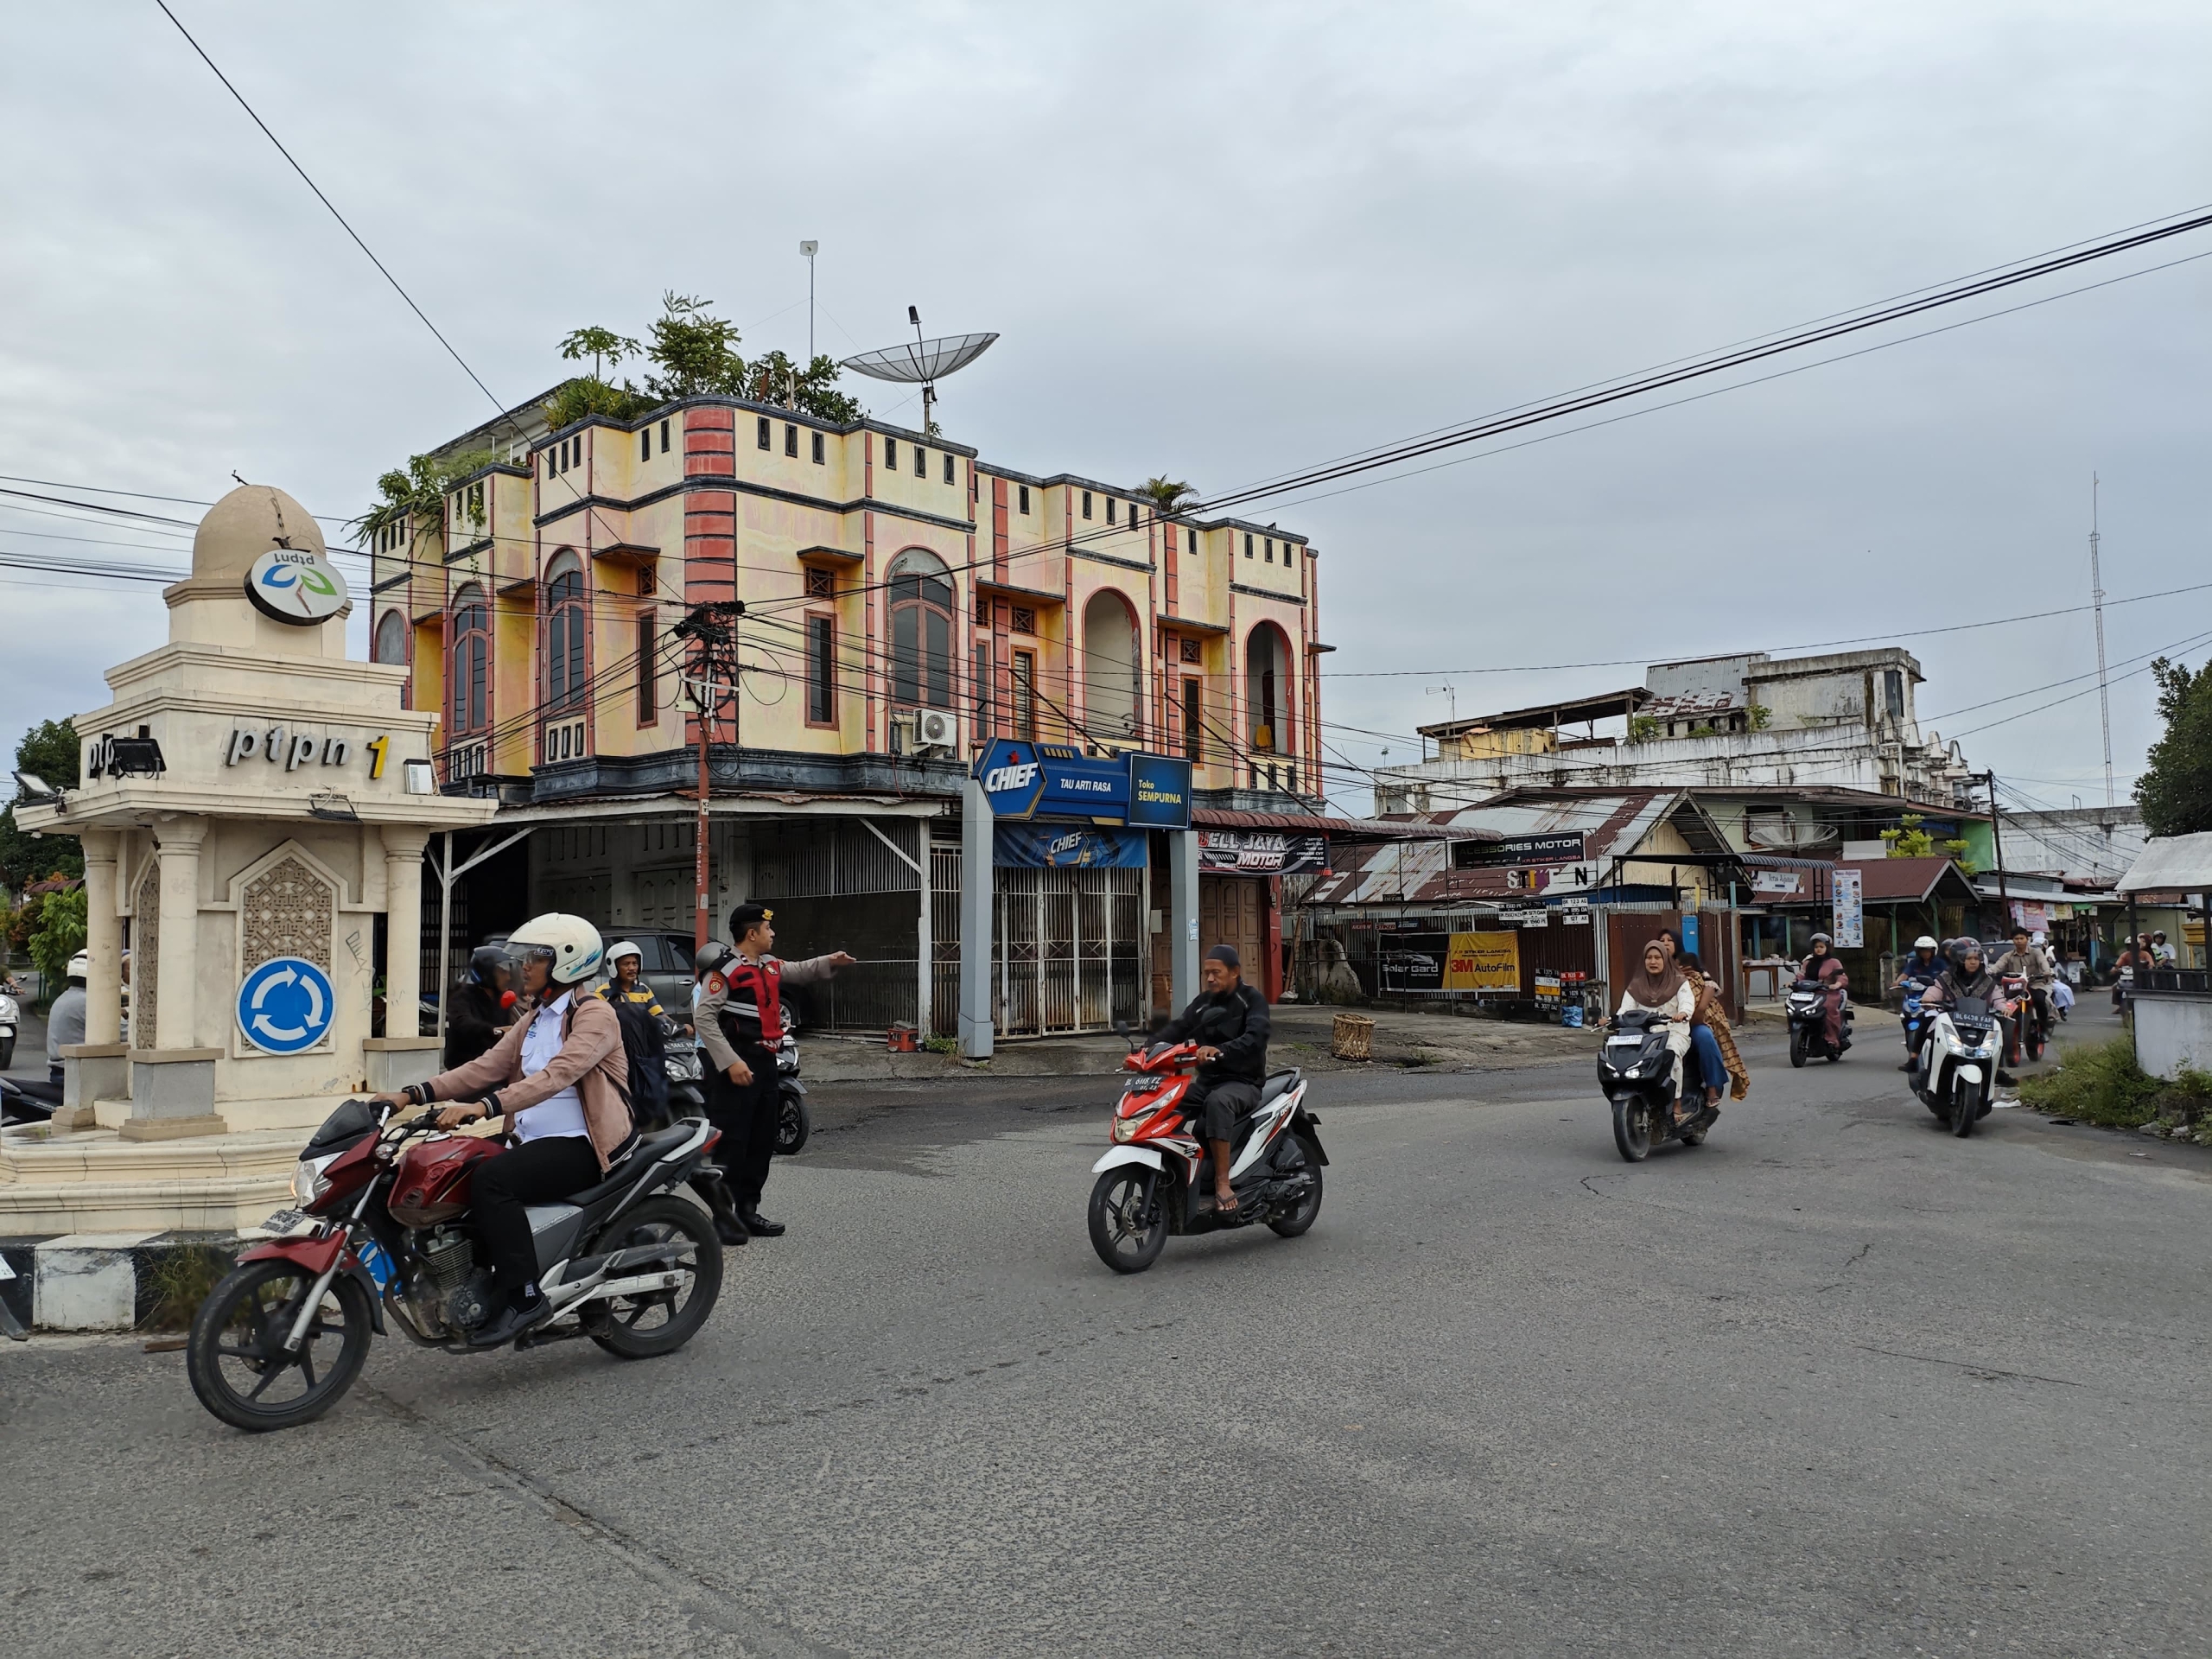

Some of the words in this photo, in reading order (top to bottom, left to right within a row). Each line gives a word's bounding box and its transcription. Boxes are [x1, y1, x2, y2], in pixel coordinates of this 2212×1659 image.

[274, 553, 315, 565] ptpn1
[229, 727, 351, 771] ptpn
[369, 735, 391, 779] 1
[987, 762, 1039, 793] CHIEF
[1139, 779, 1155, 790] Toko
[1060, 779, 1074, 790] TAU
[1075, 780, 1091, 791] ARTI
[1092, 781, 1112, 792] RASA
[1137, 791, 1182, 804] SEMPURNA
[1051, 831, 1082, 855] CHIEF
[1243, 834, 1286, 850] JAYA
[1459, 842, 1532, 855] ACESSORIES
[1535, 839, 1582, 850] MOTOR
[1238, 852, 1283, 868] MOTOR
[1411, 962, 1439, 972] Gard
[1452, 959, 1473, 972] 3M
[1474, 963, 1516, 972] AutoFilm
